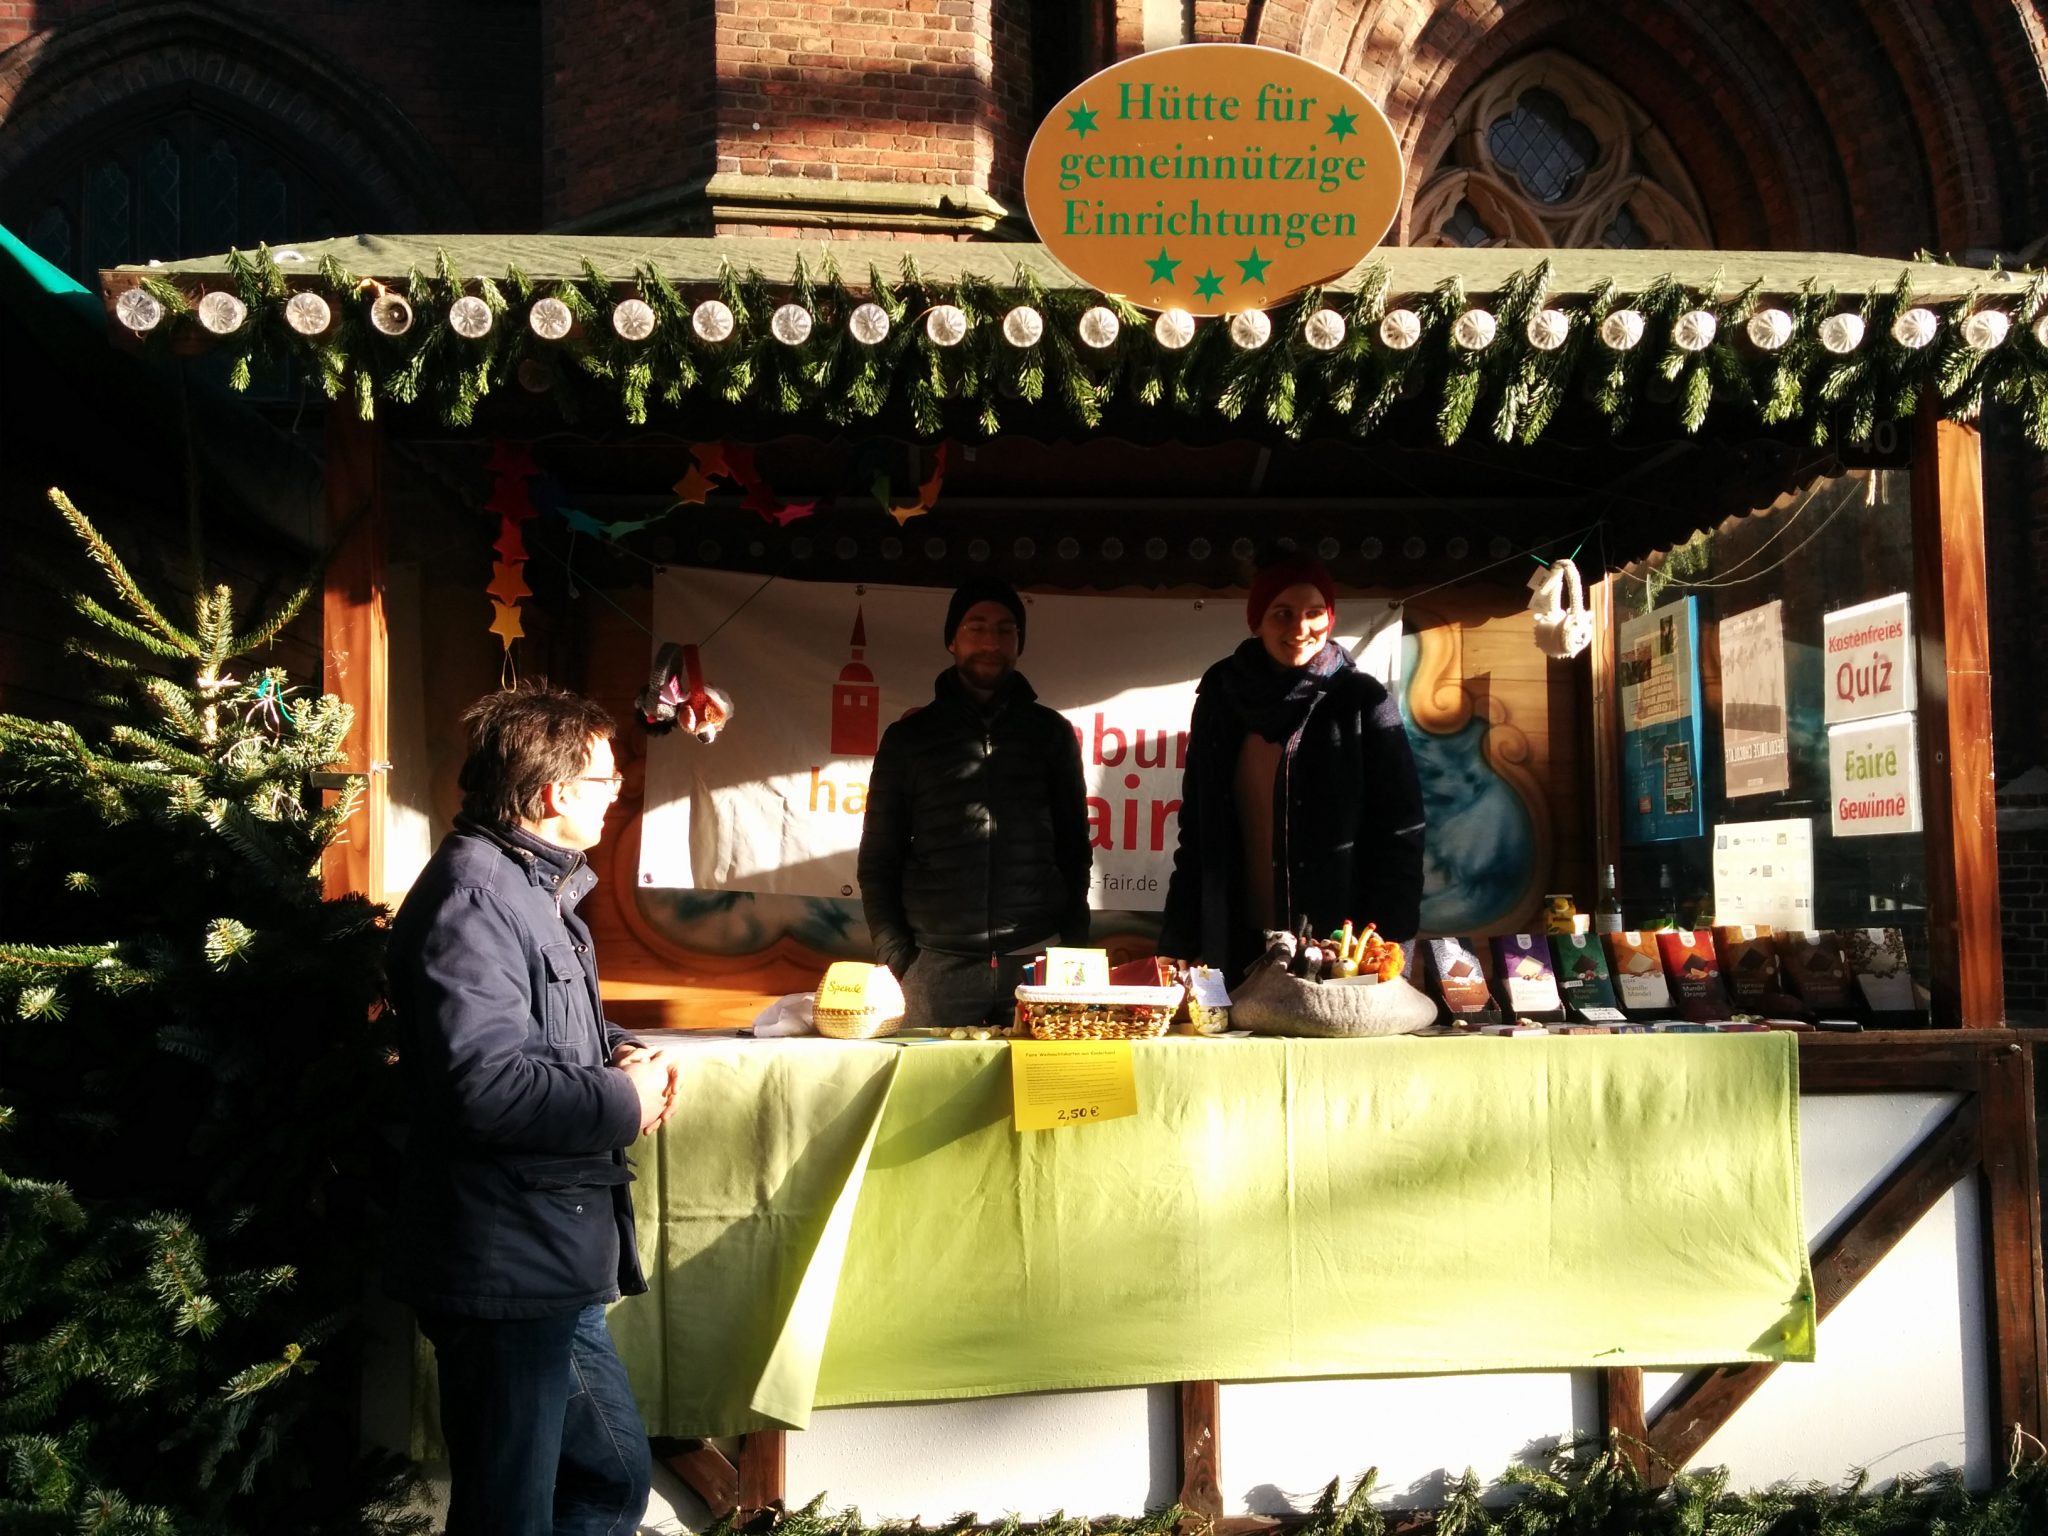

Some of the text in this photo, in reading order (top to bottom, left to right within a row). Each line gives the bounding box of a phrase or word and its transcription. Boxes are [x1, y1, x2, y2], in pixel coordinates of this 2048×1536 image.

[1117, 82, 1319, 122] Hütte für
[1058, 143, 1367, 193] gemeinnützige
[1063, 199, 1357, 249] Einrichtungen
[1828, 620, 1903, 655] Kostenfreies
[1836, 651, 1893, 705] Quiz
[1844, 743, 1898, 782] Faire
[1086, 773, 1184, 851] air
[1839, 793, 1906, 821] Gewinne
[827, 981, 862, 995] Spende
[1057, 1105, 1100, 1121] 2,50 €
